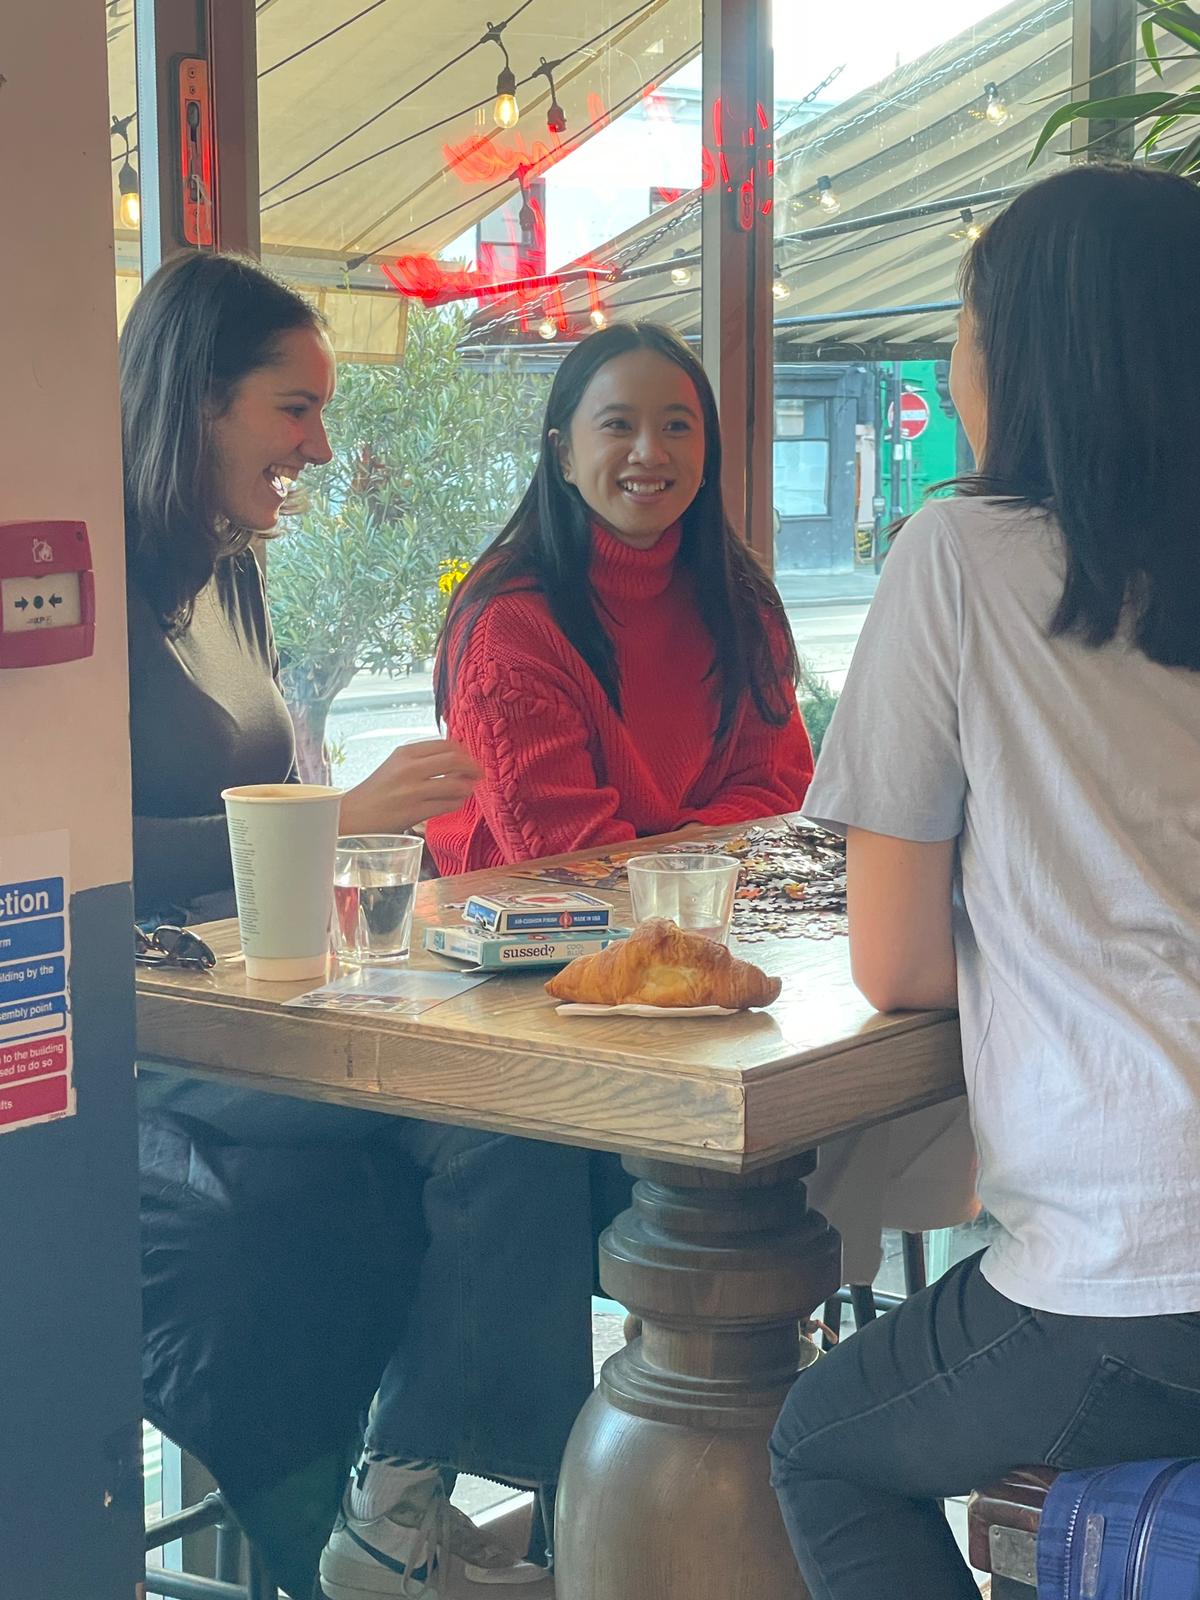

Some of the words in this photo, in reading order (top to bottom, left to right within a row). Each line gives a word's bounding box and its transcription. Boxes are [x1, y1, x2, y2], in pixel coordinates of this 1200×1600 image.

[503, 944, 555, 958] sussed?
[26, 968, 38, 979] by
[40, 965, 54, 975] the
[30, 1001, 52, 1017] point
[3, 1054, 12, 1063] to
[14, 1051, 28, 1061] the
[29, 1043, 64, 1057] building
[17, 1064, 26, 1073] to
[28, 1060, 40, 1069] do
[42, 1058, 53, 1068] so
